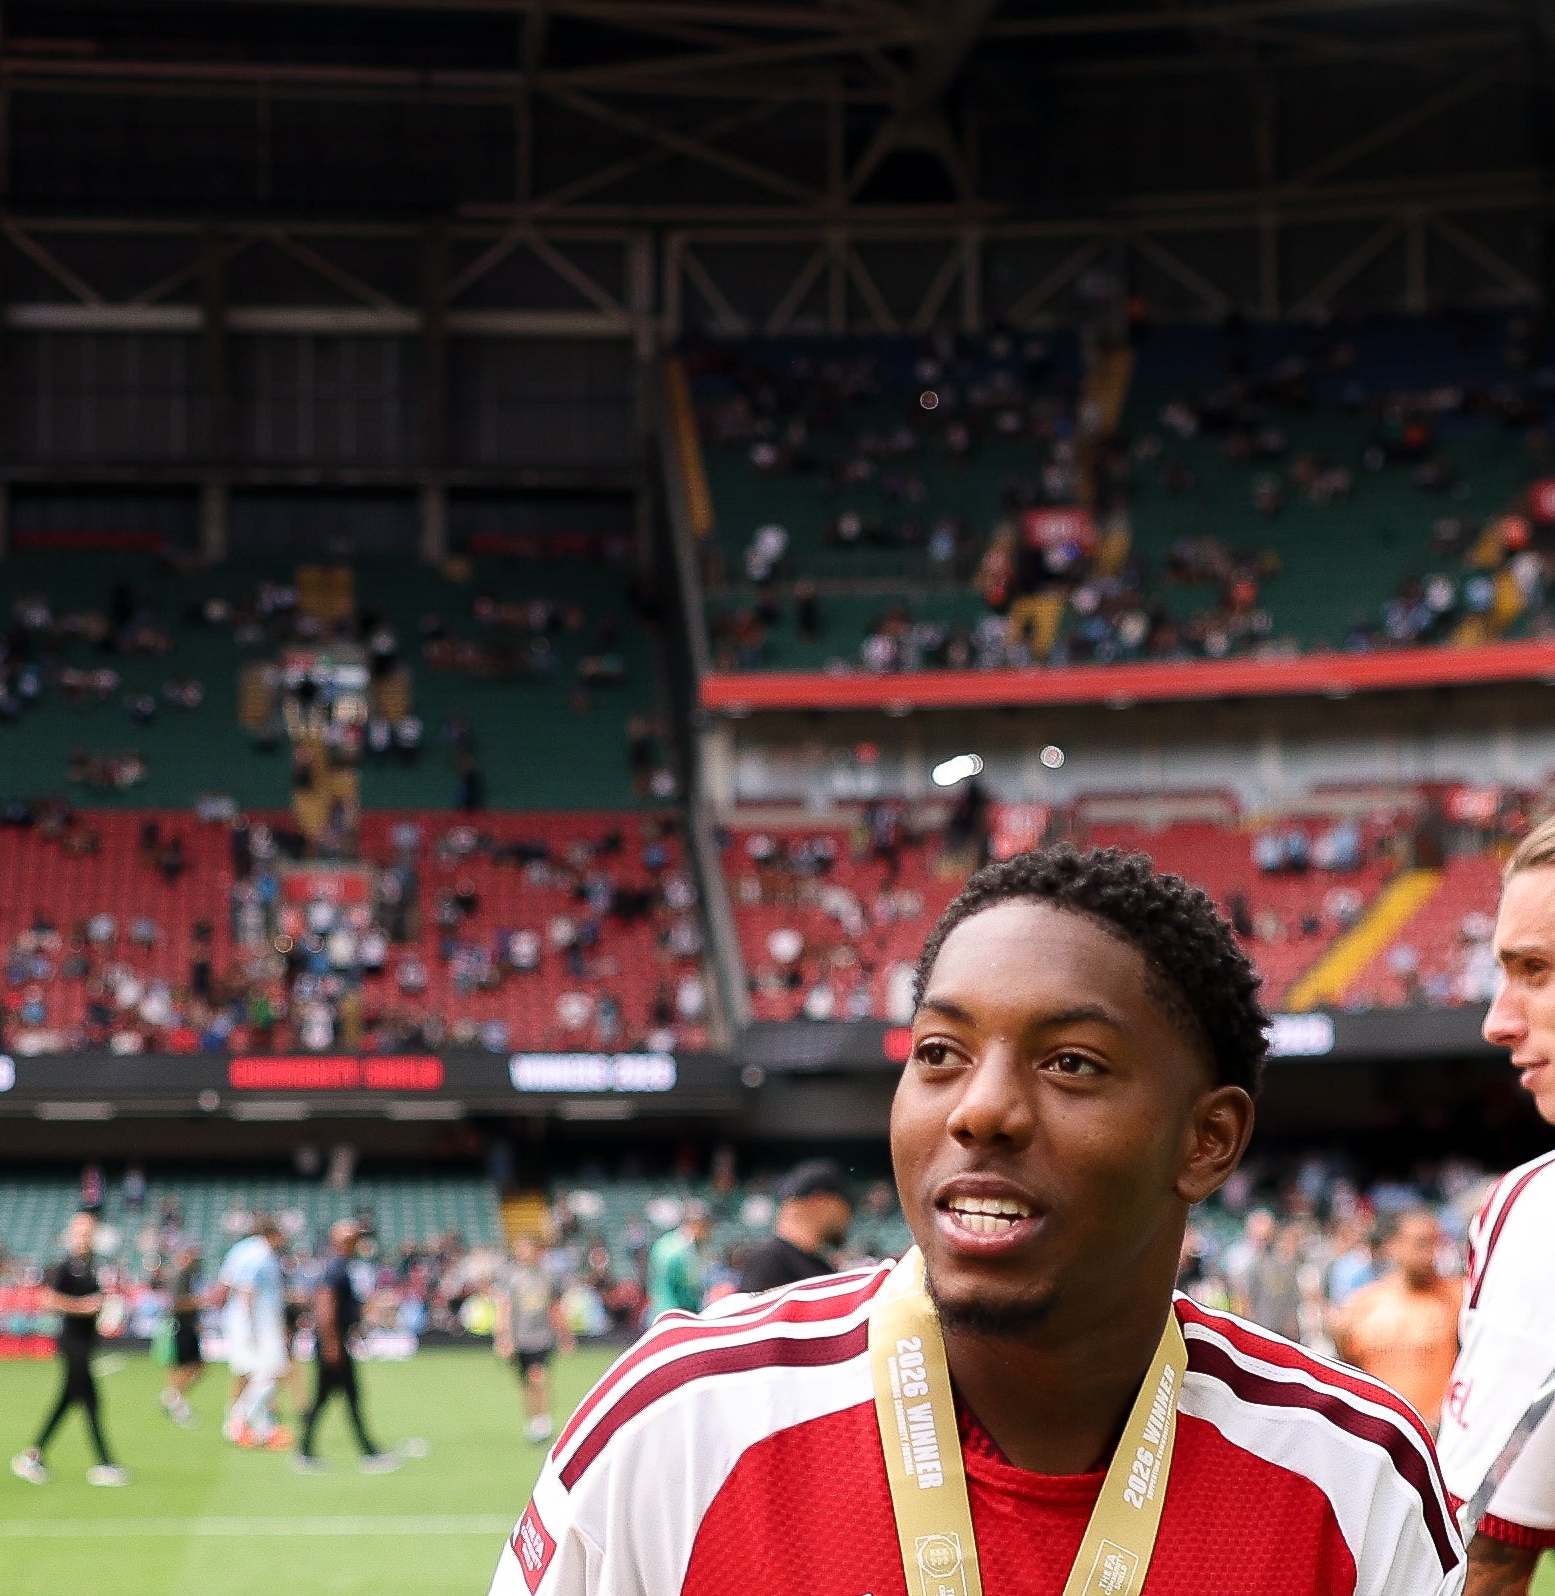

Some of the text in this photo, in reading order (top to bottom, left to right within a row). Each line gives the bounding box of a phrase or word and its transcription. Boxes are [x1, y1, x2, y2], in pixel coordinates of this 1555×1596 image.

[896, 1335, 944, 1489] 2026 WINNER
[1123, 1364, 1176, 1510] 2026 WINNER
[1105, 1554, 1118, 1571] FA
